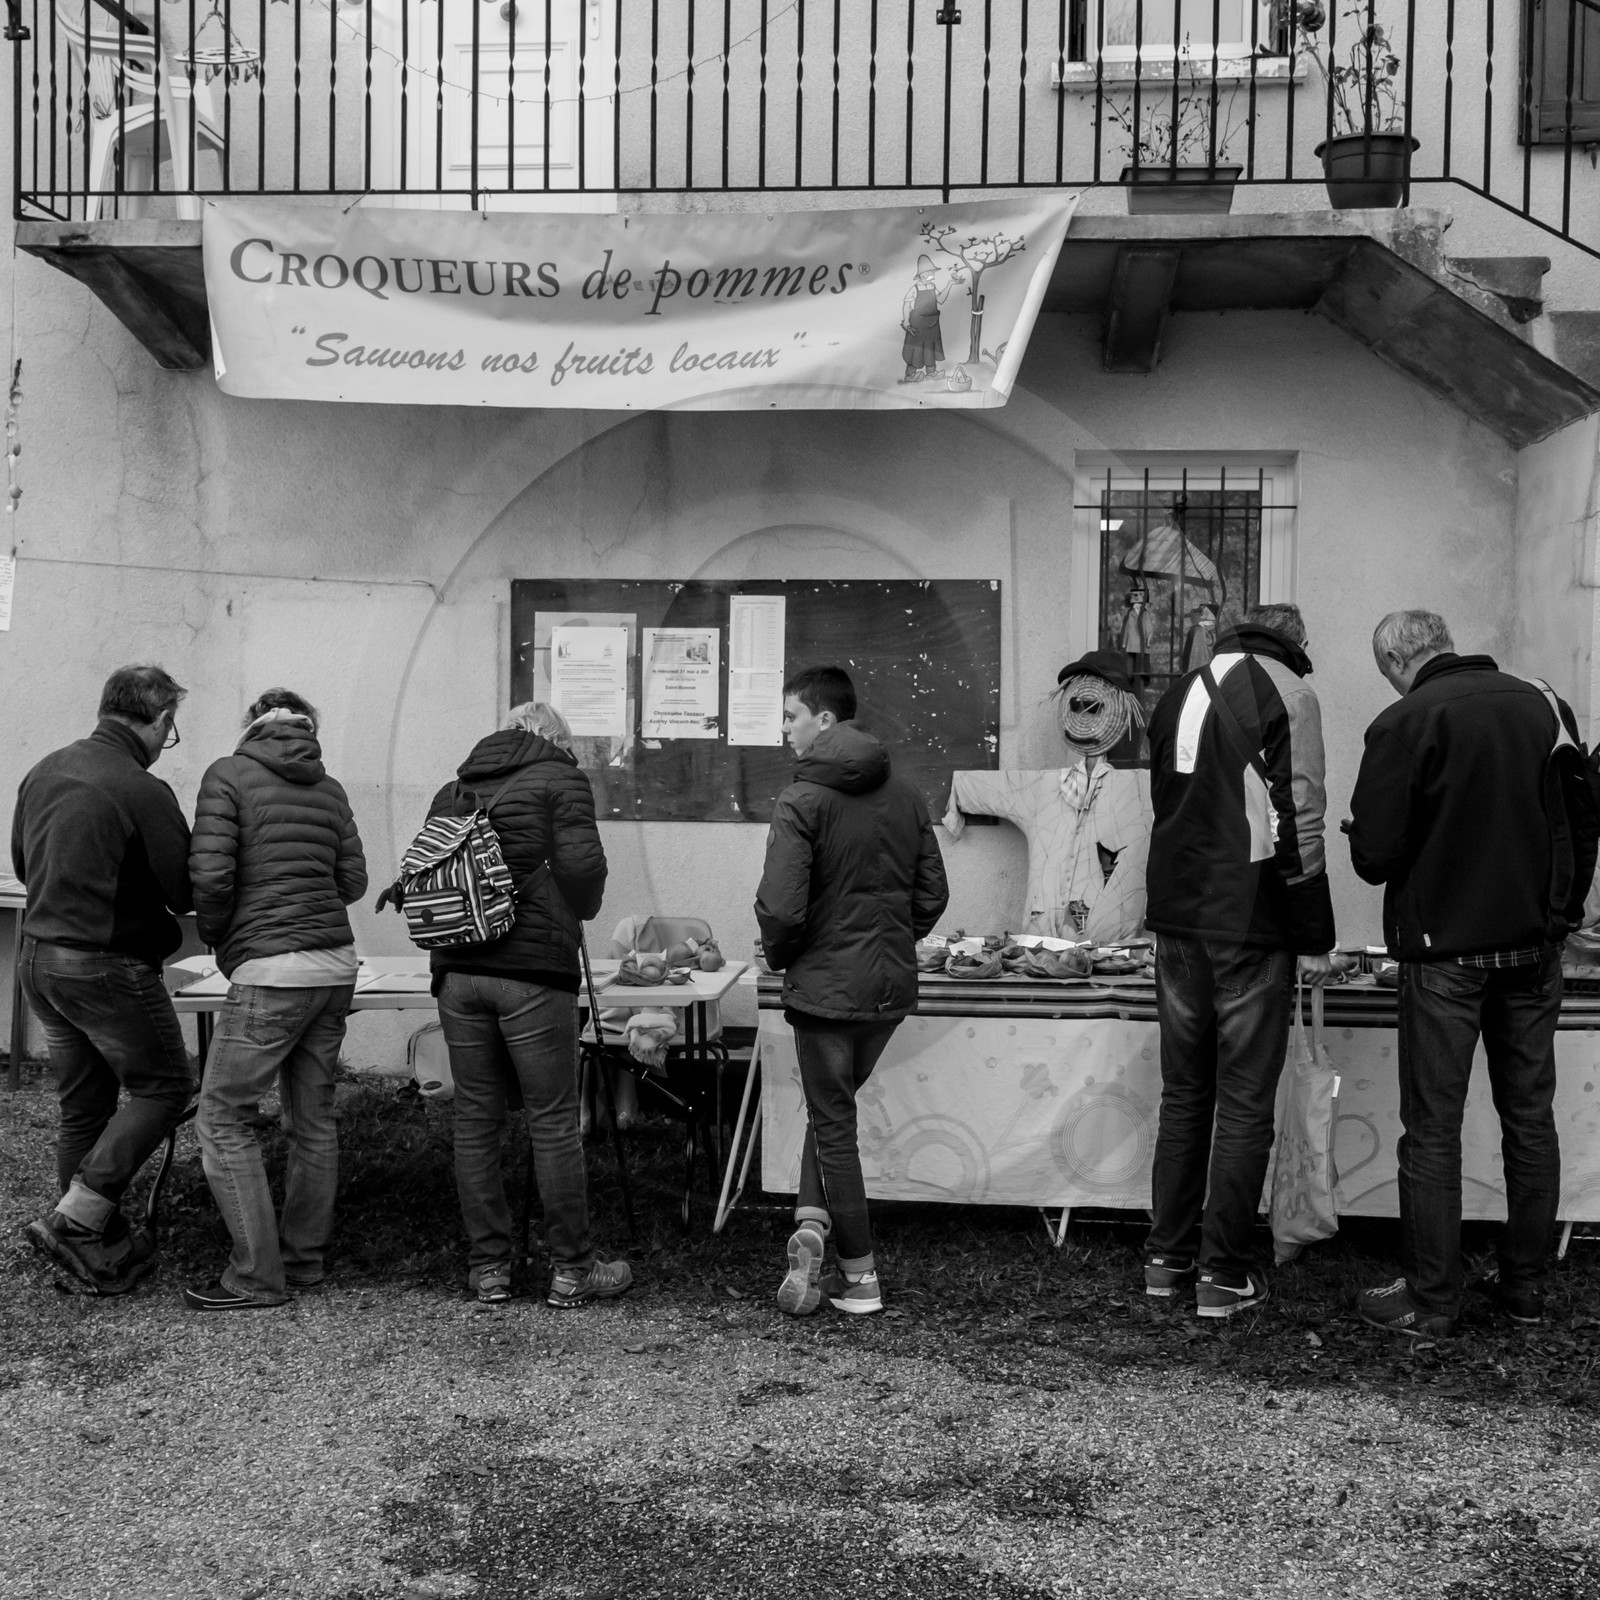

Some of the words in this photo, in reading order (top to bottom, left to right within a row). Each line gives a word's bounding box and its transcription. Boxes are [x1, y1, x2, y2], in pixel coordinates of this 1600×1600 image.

[230, 238, 559, 300] CROQUEURS
[582, 249, 632, 300] de
[482, 352, 538, 374] nos
[551, 342, 653, 387] fruits
